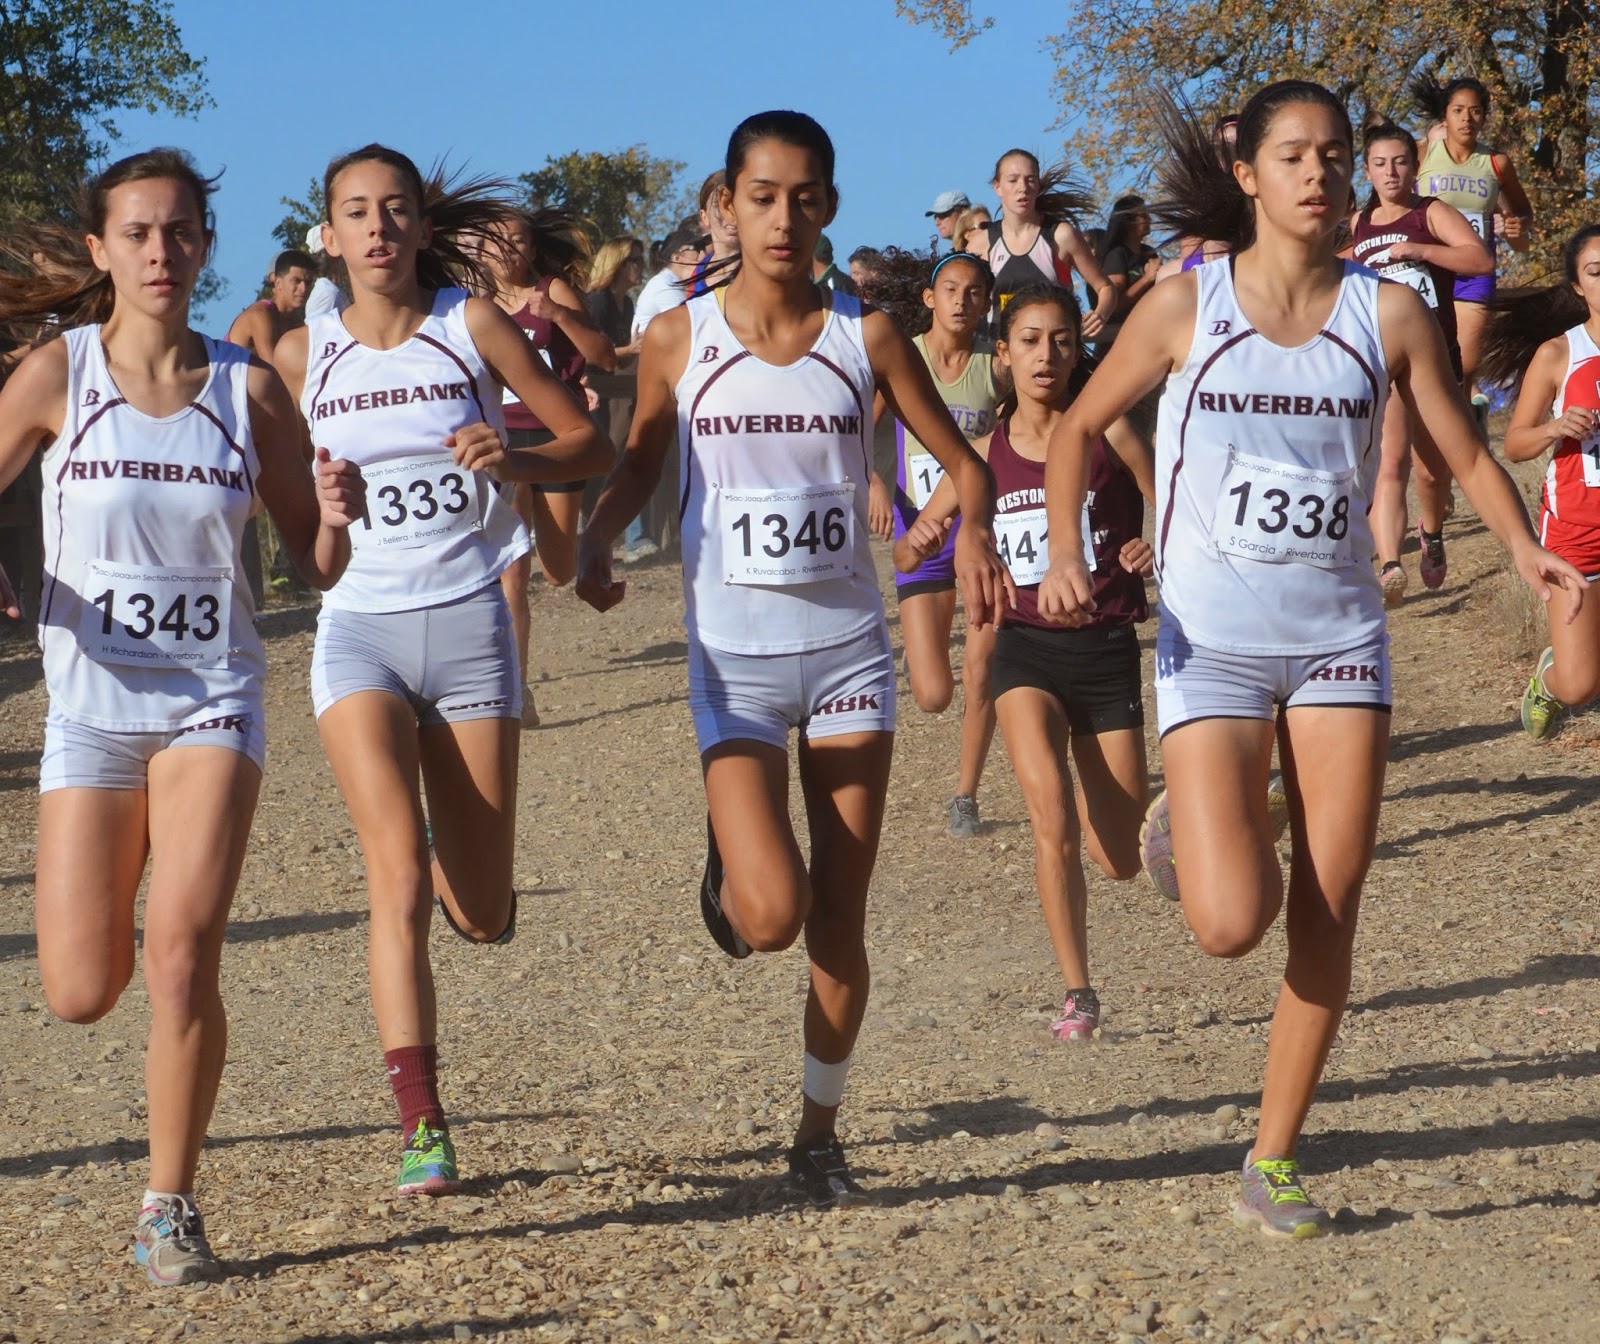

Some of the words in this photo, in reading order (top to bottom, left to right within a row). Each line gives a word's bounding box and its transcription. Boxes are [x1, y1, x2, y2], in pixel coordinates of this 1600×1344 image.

[1429, 174, 1488, 198] WOLVES
[1354, 235, 1381, 258] WESTON
[316, 383, 468, 421] RIVERBANK
[1197, 391, 1373, 419] RIVERBANK
[695, 414, 860, 437] RIVERBANK
[70, 460, 245, 492] RIVERBANK
[385, 467, 409, 475] Section
[1281, 471, 1309, 482] Section
[729, 495, 772, 503] Sac-Joaquin
[774, 494, 800, 502] Section
[801, 490, 846, 500] Championships
[996, 488, 1046, 513] WESTON
[1229, 480, 1350, 541] 1338
[377, 538, 382, 546] J
[414, 525, 452, 539] Riverbank
[731, 507, 846, 558] 1346
[1229, 536, 1236, 546] S
[1238, 538, 1276, 555] Garcia
[1285, 547, 1337, 561] Riverbank
[95, 568, 141, 580] Sac-Joaquin
[143, 574, 170, 582] Section
[171, 574, 222, 583] Championships
[753, 567, 796, 576] Ruvalcaba
[802, 563, 835, 574] Riverbank
[93, 589, 220, 642] 1343
[110, 647, 159, 659] Richardson
[165, 652, 205, 660] Riverbank
[1309, 665, 1380, 682] RBK
